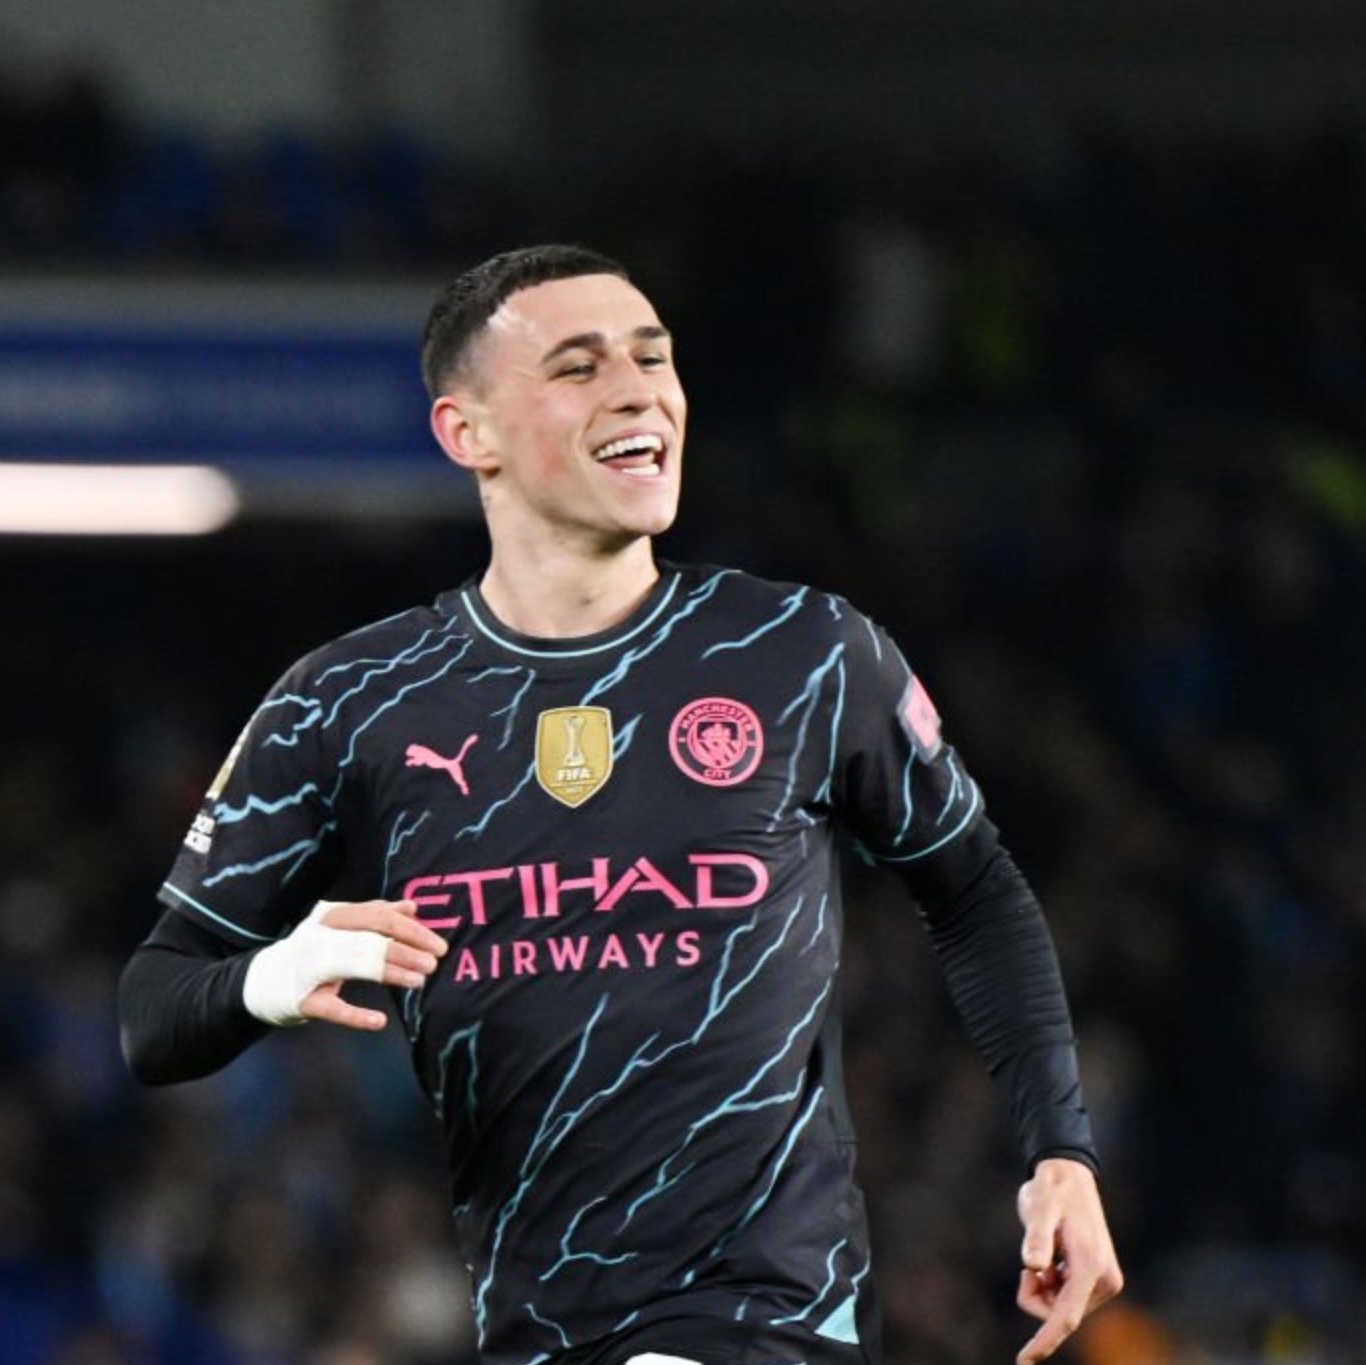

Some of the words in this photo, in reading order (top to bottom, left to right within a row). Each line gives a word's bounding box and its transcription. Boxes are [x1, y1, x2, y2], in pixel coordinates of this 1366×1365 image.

[678, 703, 754, 732] MANCHESTER
[556, 766, 592, 783] FIFA
[703, 767, 733, 781] CITY
[402, 853, 770, 930] ETIHAD
[455, 930, 702, 983] AIRWAYS
